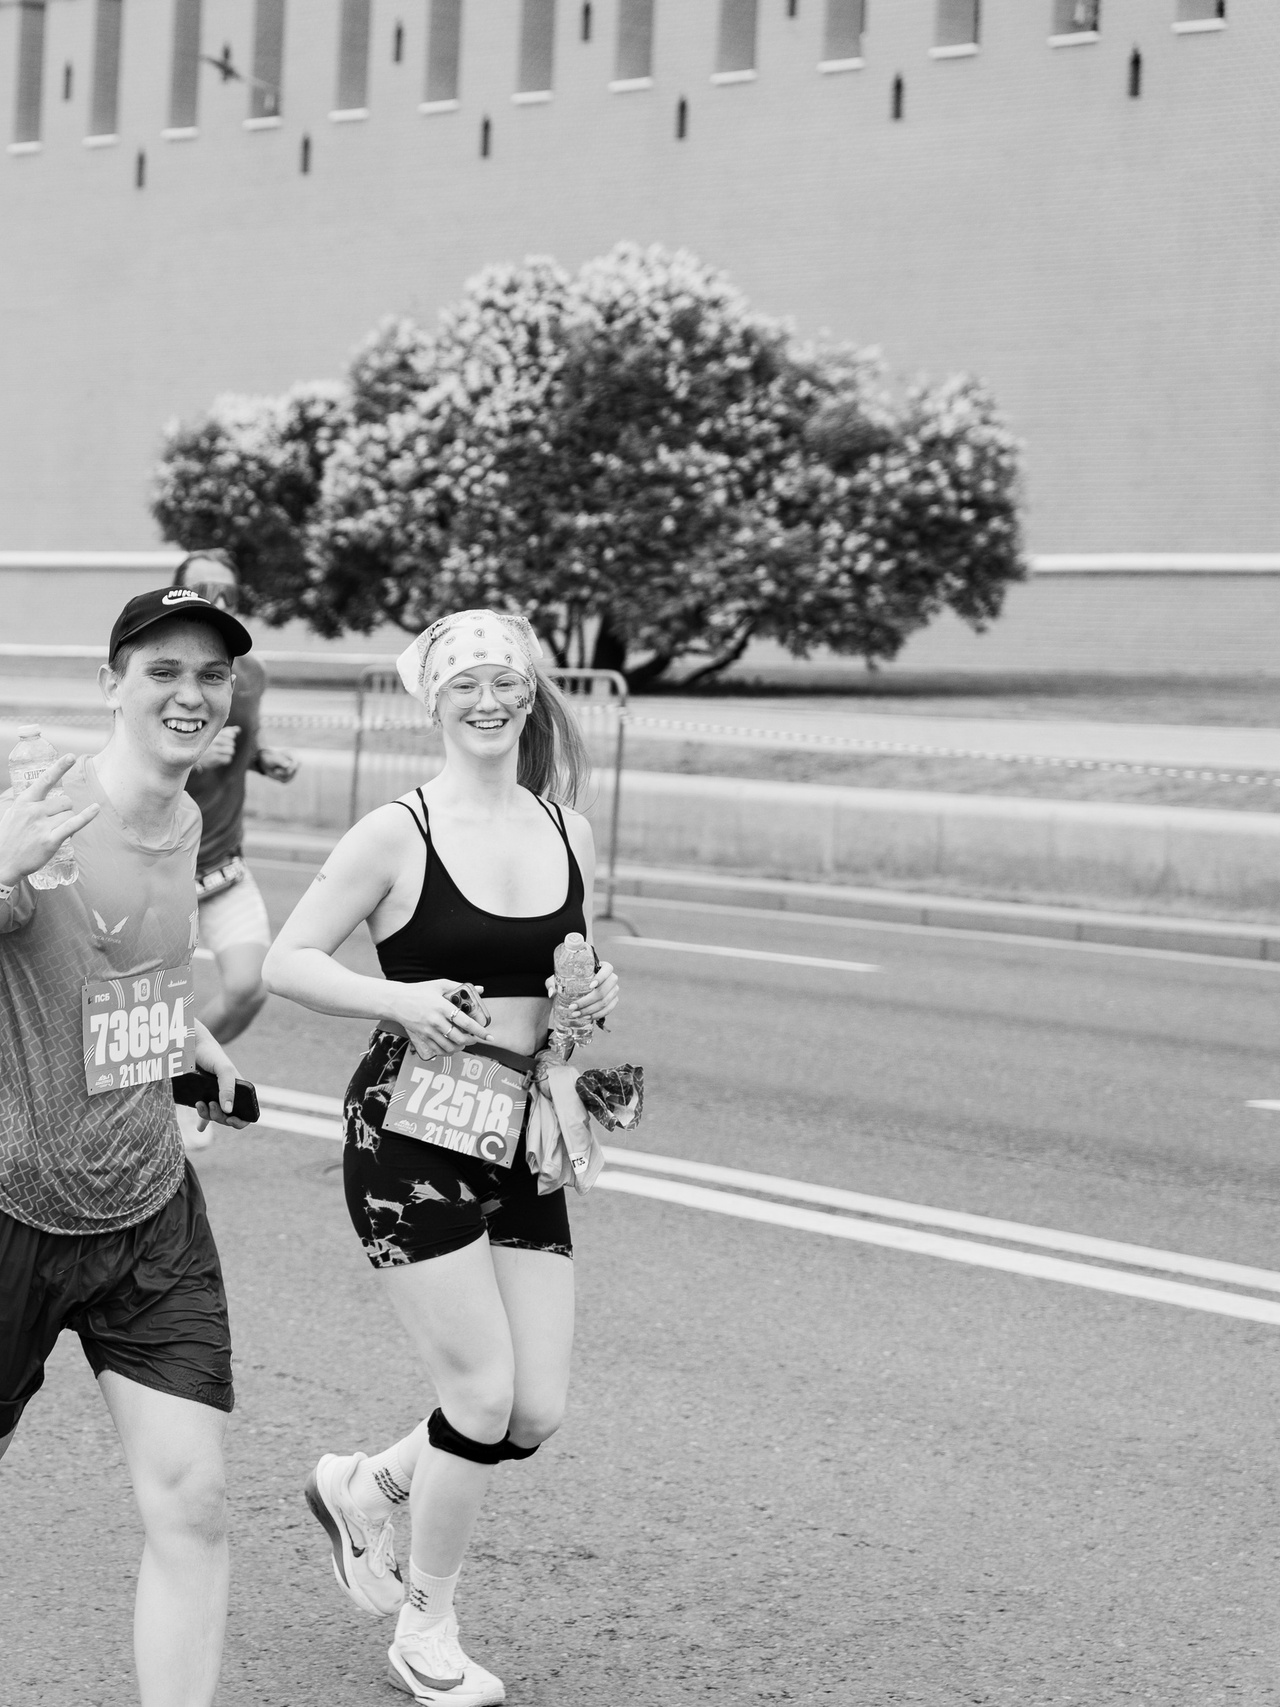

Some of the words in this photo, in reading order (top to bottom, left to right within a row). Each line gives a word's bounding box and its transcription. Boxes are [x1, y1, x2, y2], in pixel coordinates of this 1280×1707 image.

[94, 992, 111, 1003] ПСБ
[90, 997, 188, 1067] 73694
[119, 1057, 163, 1089] 21.1KM
[405, 1066, 514, 1138] 72518
